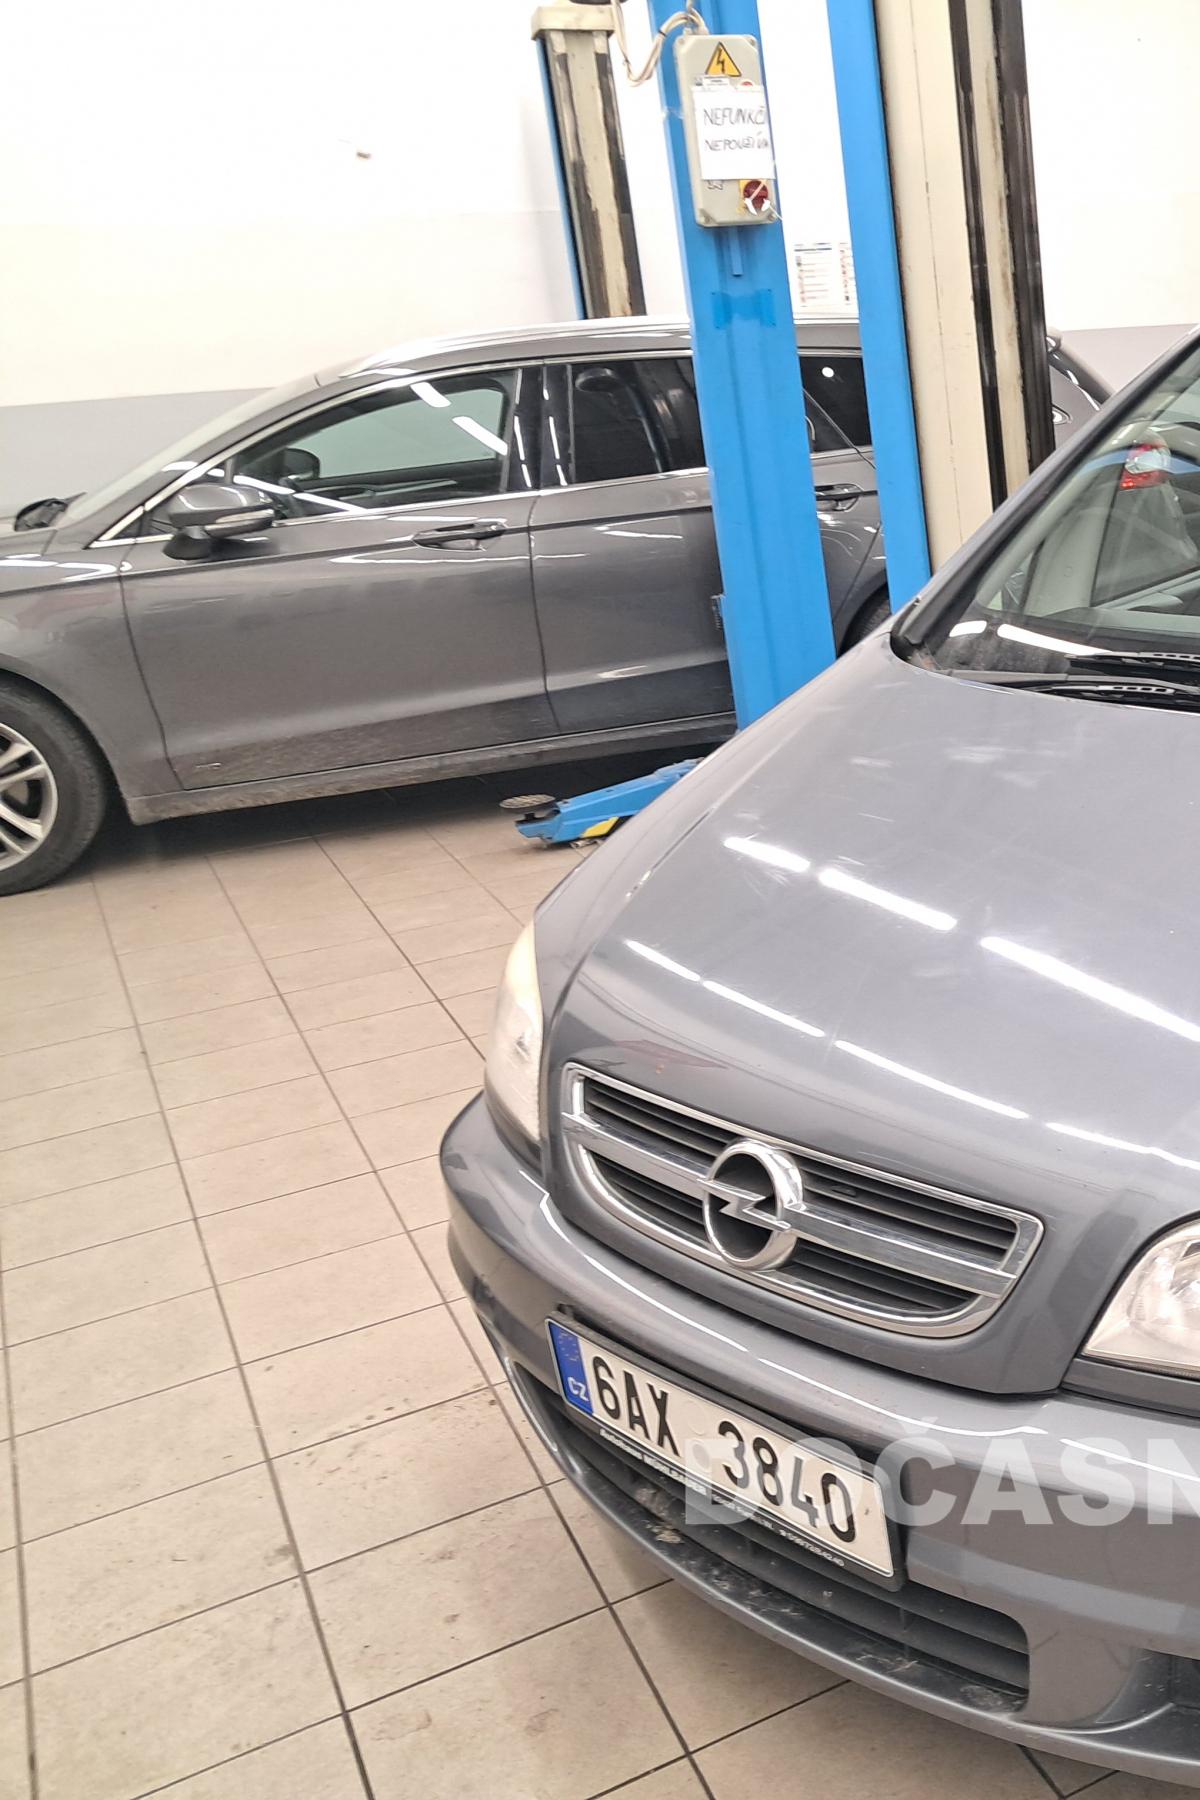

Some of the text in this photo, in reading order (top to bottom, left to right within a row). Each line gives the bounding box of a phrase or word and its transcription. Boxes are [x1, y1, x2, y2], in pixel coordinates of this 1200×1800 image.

[568, 1376, 589, 1402] CZ
[592, 1356, 856, 1543] 6AX 3840
